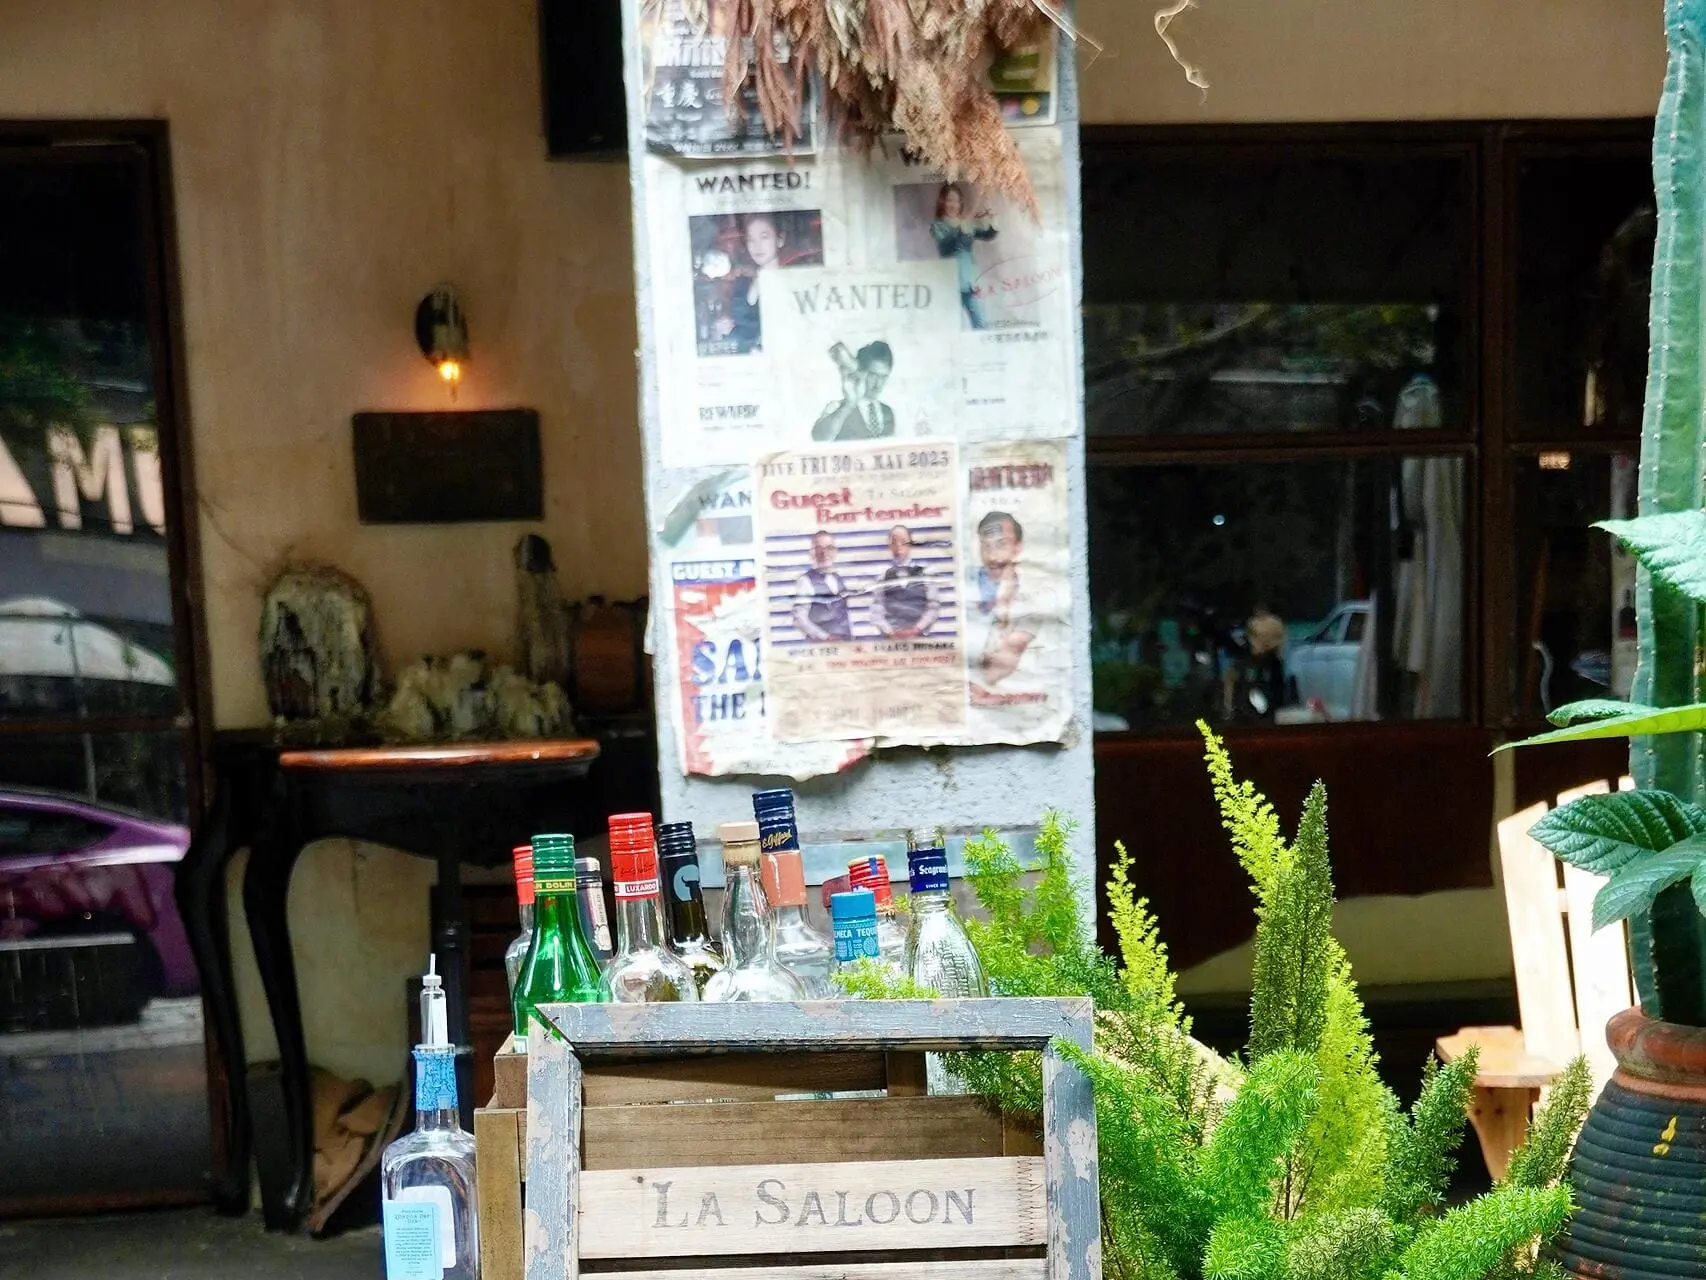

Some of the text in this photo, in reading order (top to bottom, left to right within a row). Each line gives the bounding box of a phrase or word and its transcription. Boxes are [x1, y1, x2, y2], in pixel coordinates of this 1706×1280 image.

[697, 171, 811, 193] WANTED!
[793, 283, 932, 315] WANTED
[770, 487, 852, 510] Guest
[816, 503, 950, 524] Bartender
[691, 692, 746, 722] THE
[545, 881, 573, 890] DOLIN
[626, 882, 657, 893] LUXARDO
